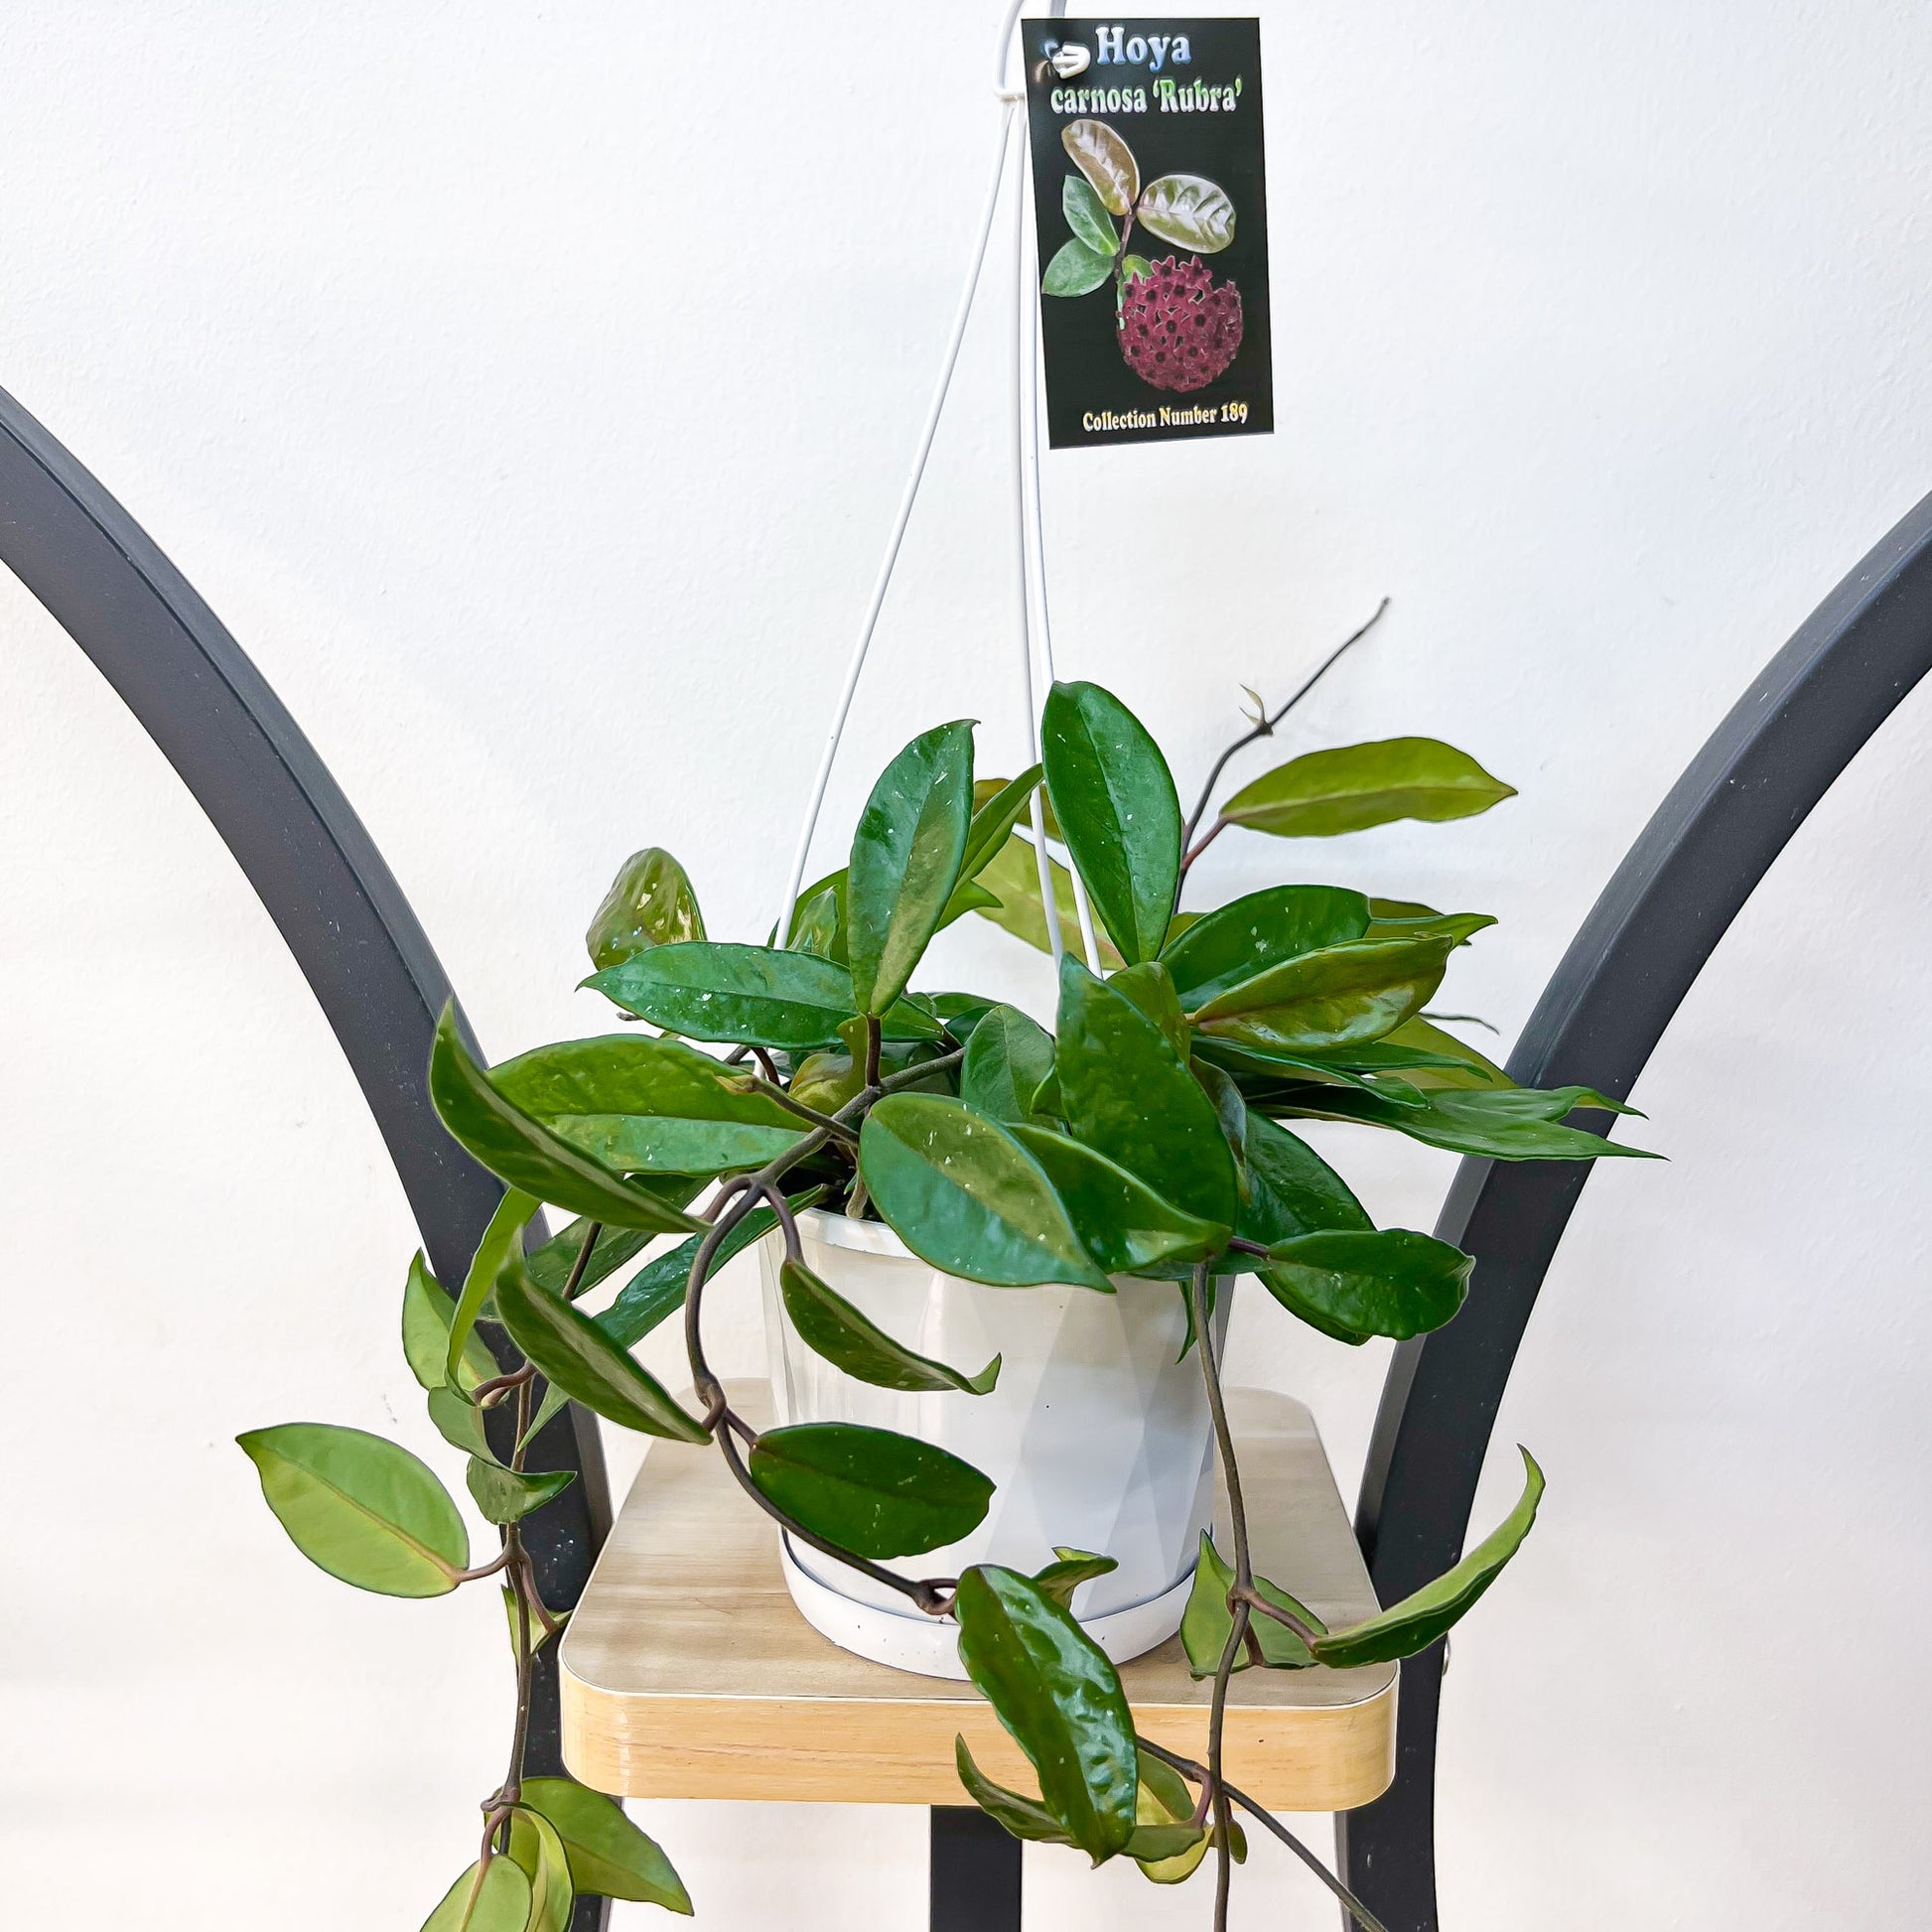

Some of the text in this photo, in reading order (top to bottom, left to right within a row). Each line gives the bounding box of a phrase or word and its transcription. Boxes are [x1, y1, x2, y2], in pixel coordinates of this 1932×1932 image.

[1095, 25, 1191, 72] Hoya
[1050, 86, 1148, 114] carnosa
[1082, 402, 1248, 432] Collection Number 189
